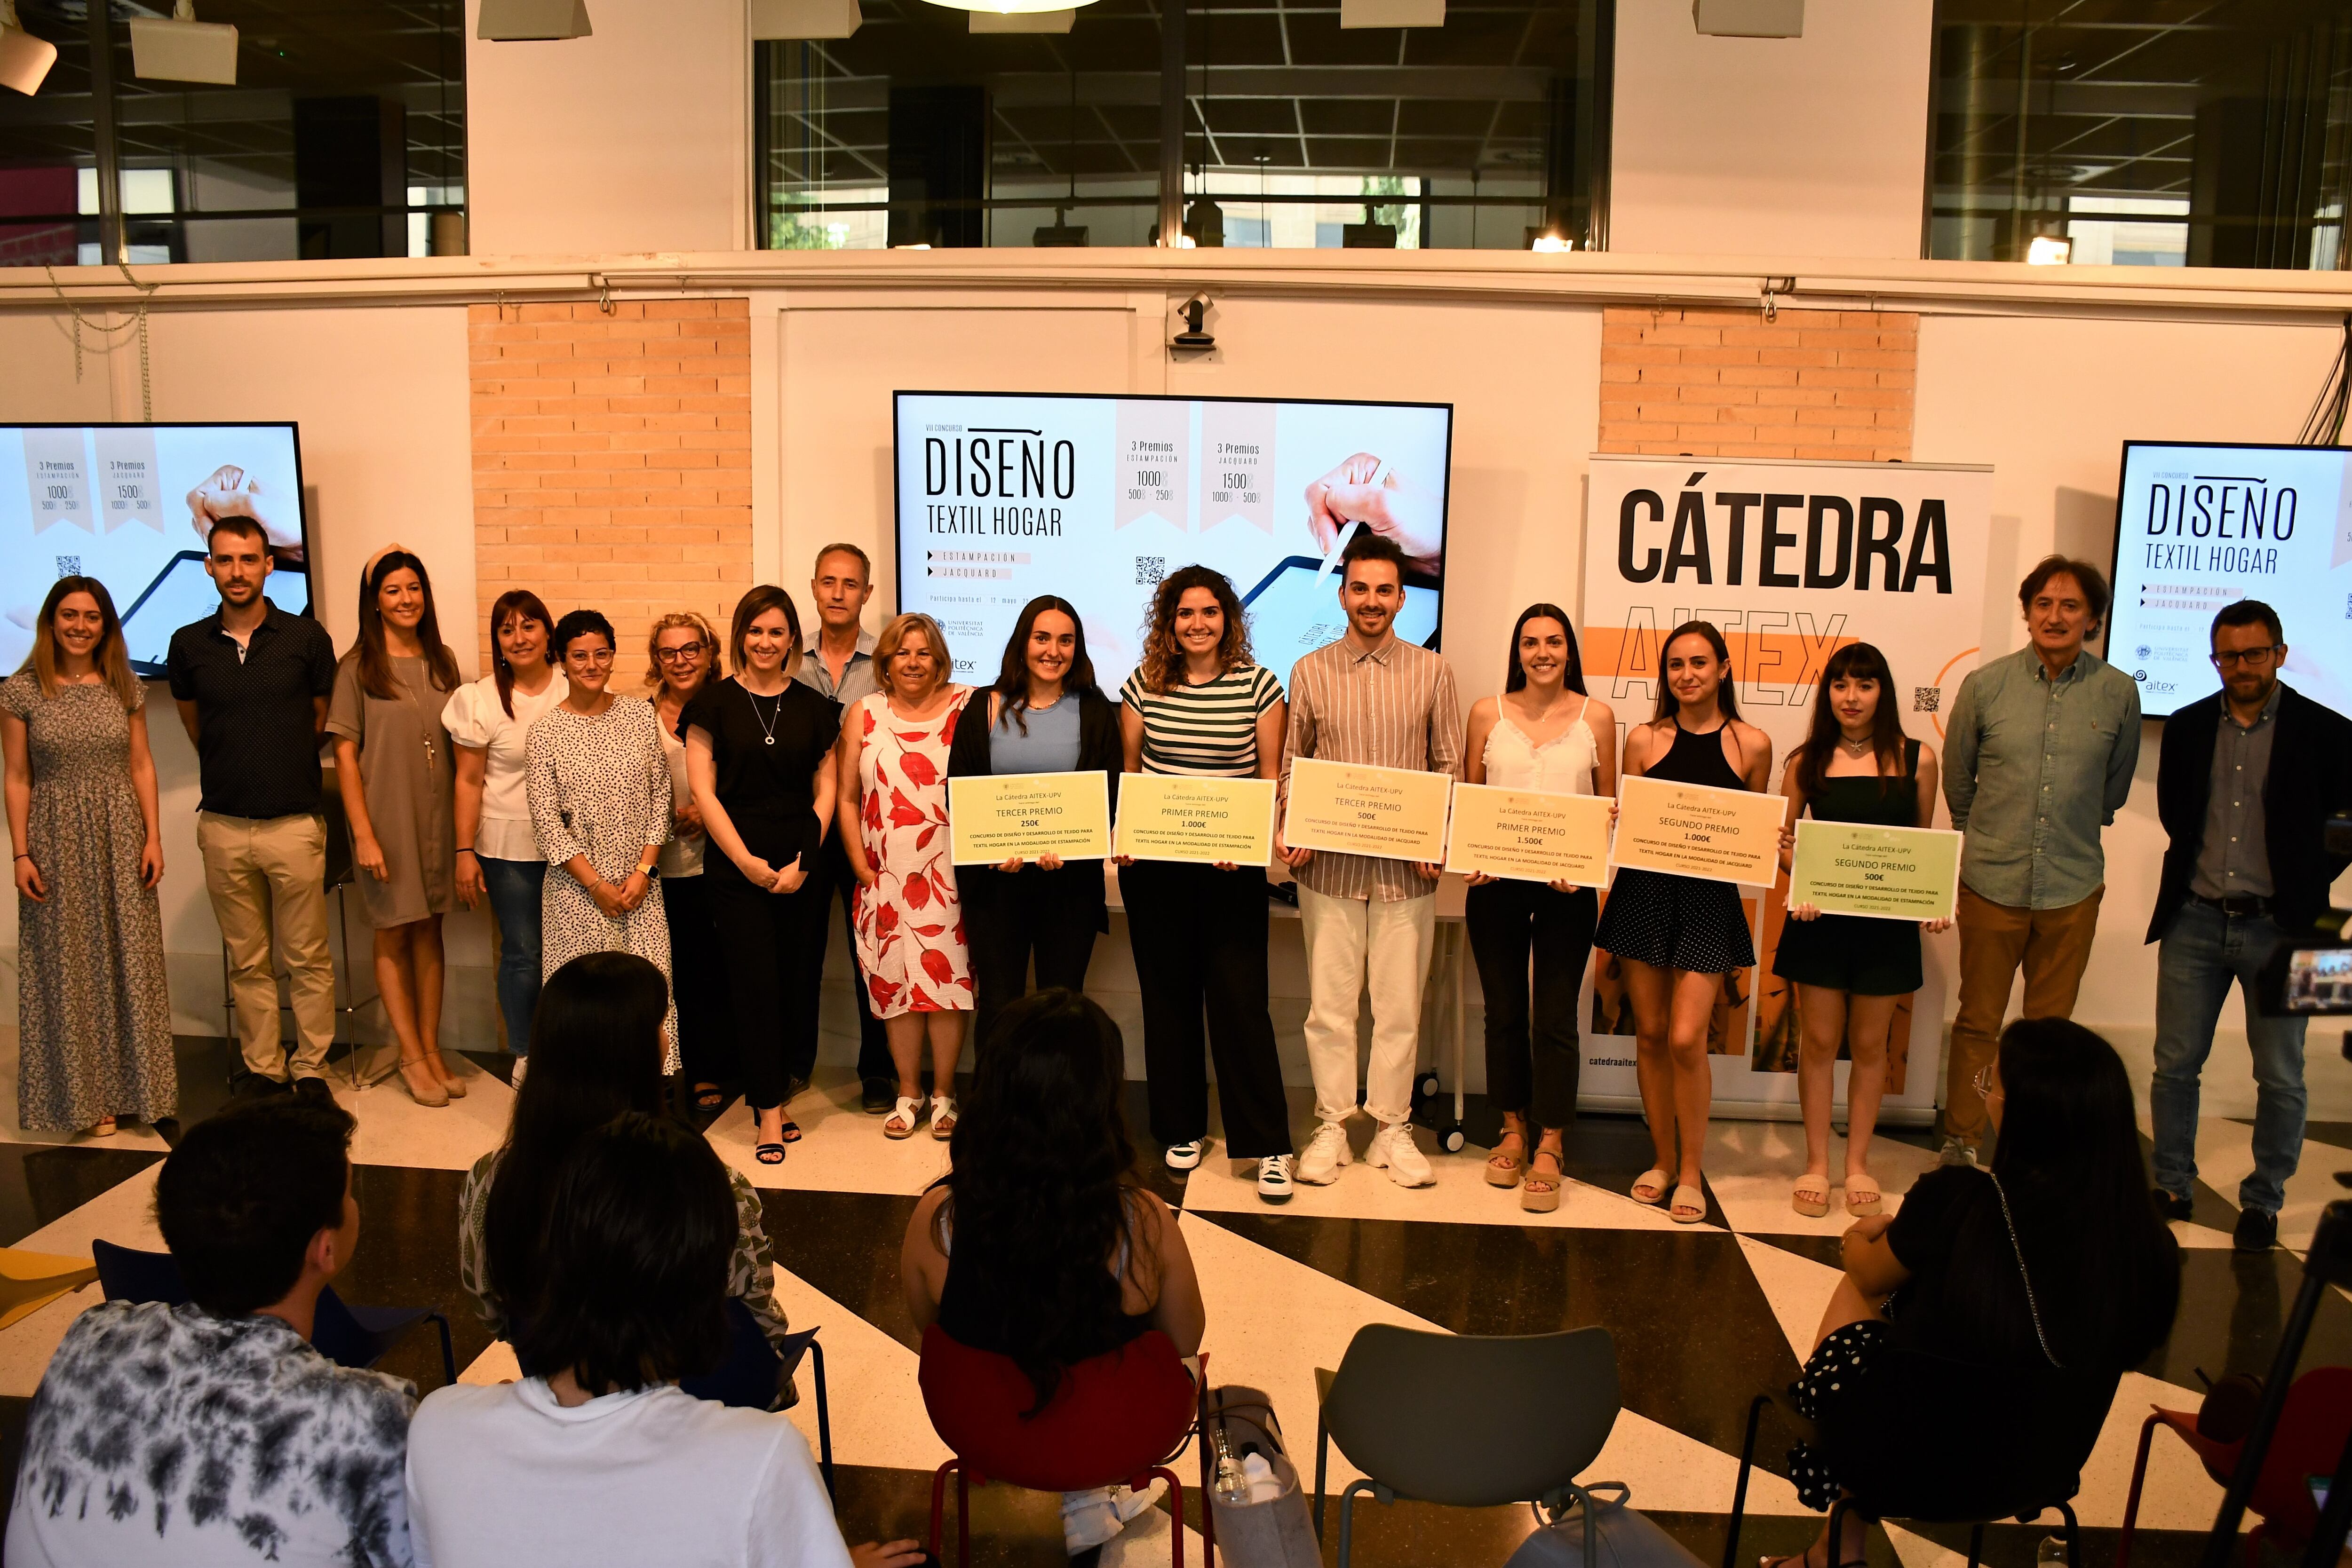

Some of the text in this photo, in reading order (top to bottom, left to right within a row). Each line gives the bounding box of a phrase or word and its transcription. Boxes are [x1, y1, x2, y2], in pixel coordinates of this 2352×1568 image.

[1131, 441, 1173, 452] 3 Premios
[1217, 443, 1259, 454] 3 Premios
[926, 428, 1074, 499] DISEÑO
[1127, 454, 1177, 463] ESTAMPACIÓN
[1219, 457, 1257, 466] JACQUARD
[40, 461, 74, 470] 3 Premios
[110, 461, 145, 470] 3 Premios
[2147, 476, 2297, 541] DISEÑO
[927, 505, 1061, 536] TEXTIL HOGAR
[1618, 472, 1952, 594] CÁTEDRA
[943, 551, 1015, 562] ESTAMPACIÓN
[2145, 543, 2278, 574] TEXTIL HOGAR
[943, 568, 997, 578] JACQUARD
[2157, 585, 2227, 596] ESTAMPACIÓN
[2155, 600, 2207, 610] JACQUARD
[1612, 607, 1847, 705] AEX
[952, 658, 974, 670] itex
[2145, 681, 2176, 692] aitex
[1345, 783, 1369, 791] Cátedra
[1370, 786, 1403, 795] AITEX-UPV
[1334, 797, 1401, 812] TERCER PREMIO
[1676, 803, 1701, 812] Cátedra
[1702, 807, 1736, 817] AITEX-UPV
[996, 807, 1063, 817] TERCER PREMIO
[1357, 812, 1376, 820] 500€
[1507, 808, 1532, 816] Cátedra
[1533, 810, 1565, 819] AITEX-UPV
[1497, 823, 1565, 836] PRIMER PREMIO
[1658, 816, 1740, 835] SEGUNDO PREMIO
[1517, 836, 1543, 846] 1.500€
[1684, 832, 1711, 843] 1.000€
[1632, 837, 1660, 846] CONCURSO
[1691, 846, 1722, 855] DESARROLLO
[1688, 855, 1718, 864] MODALIDAD
[1726, 860, 1752, 869] JACQUARD
[1835, 859, 1915, 872] SEGUNDO PREMIO
[1864, 873, 1884, 881] 500€
[1900, 897, 1935, 905] ESTAMPACIÓN
[1589, 1057, 1637, 1067] catedraaitex
